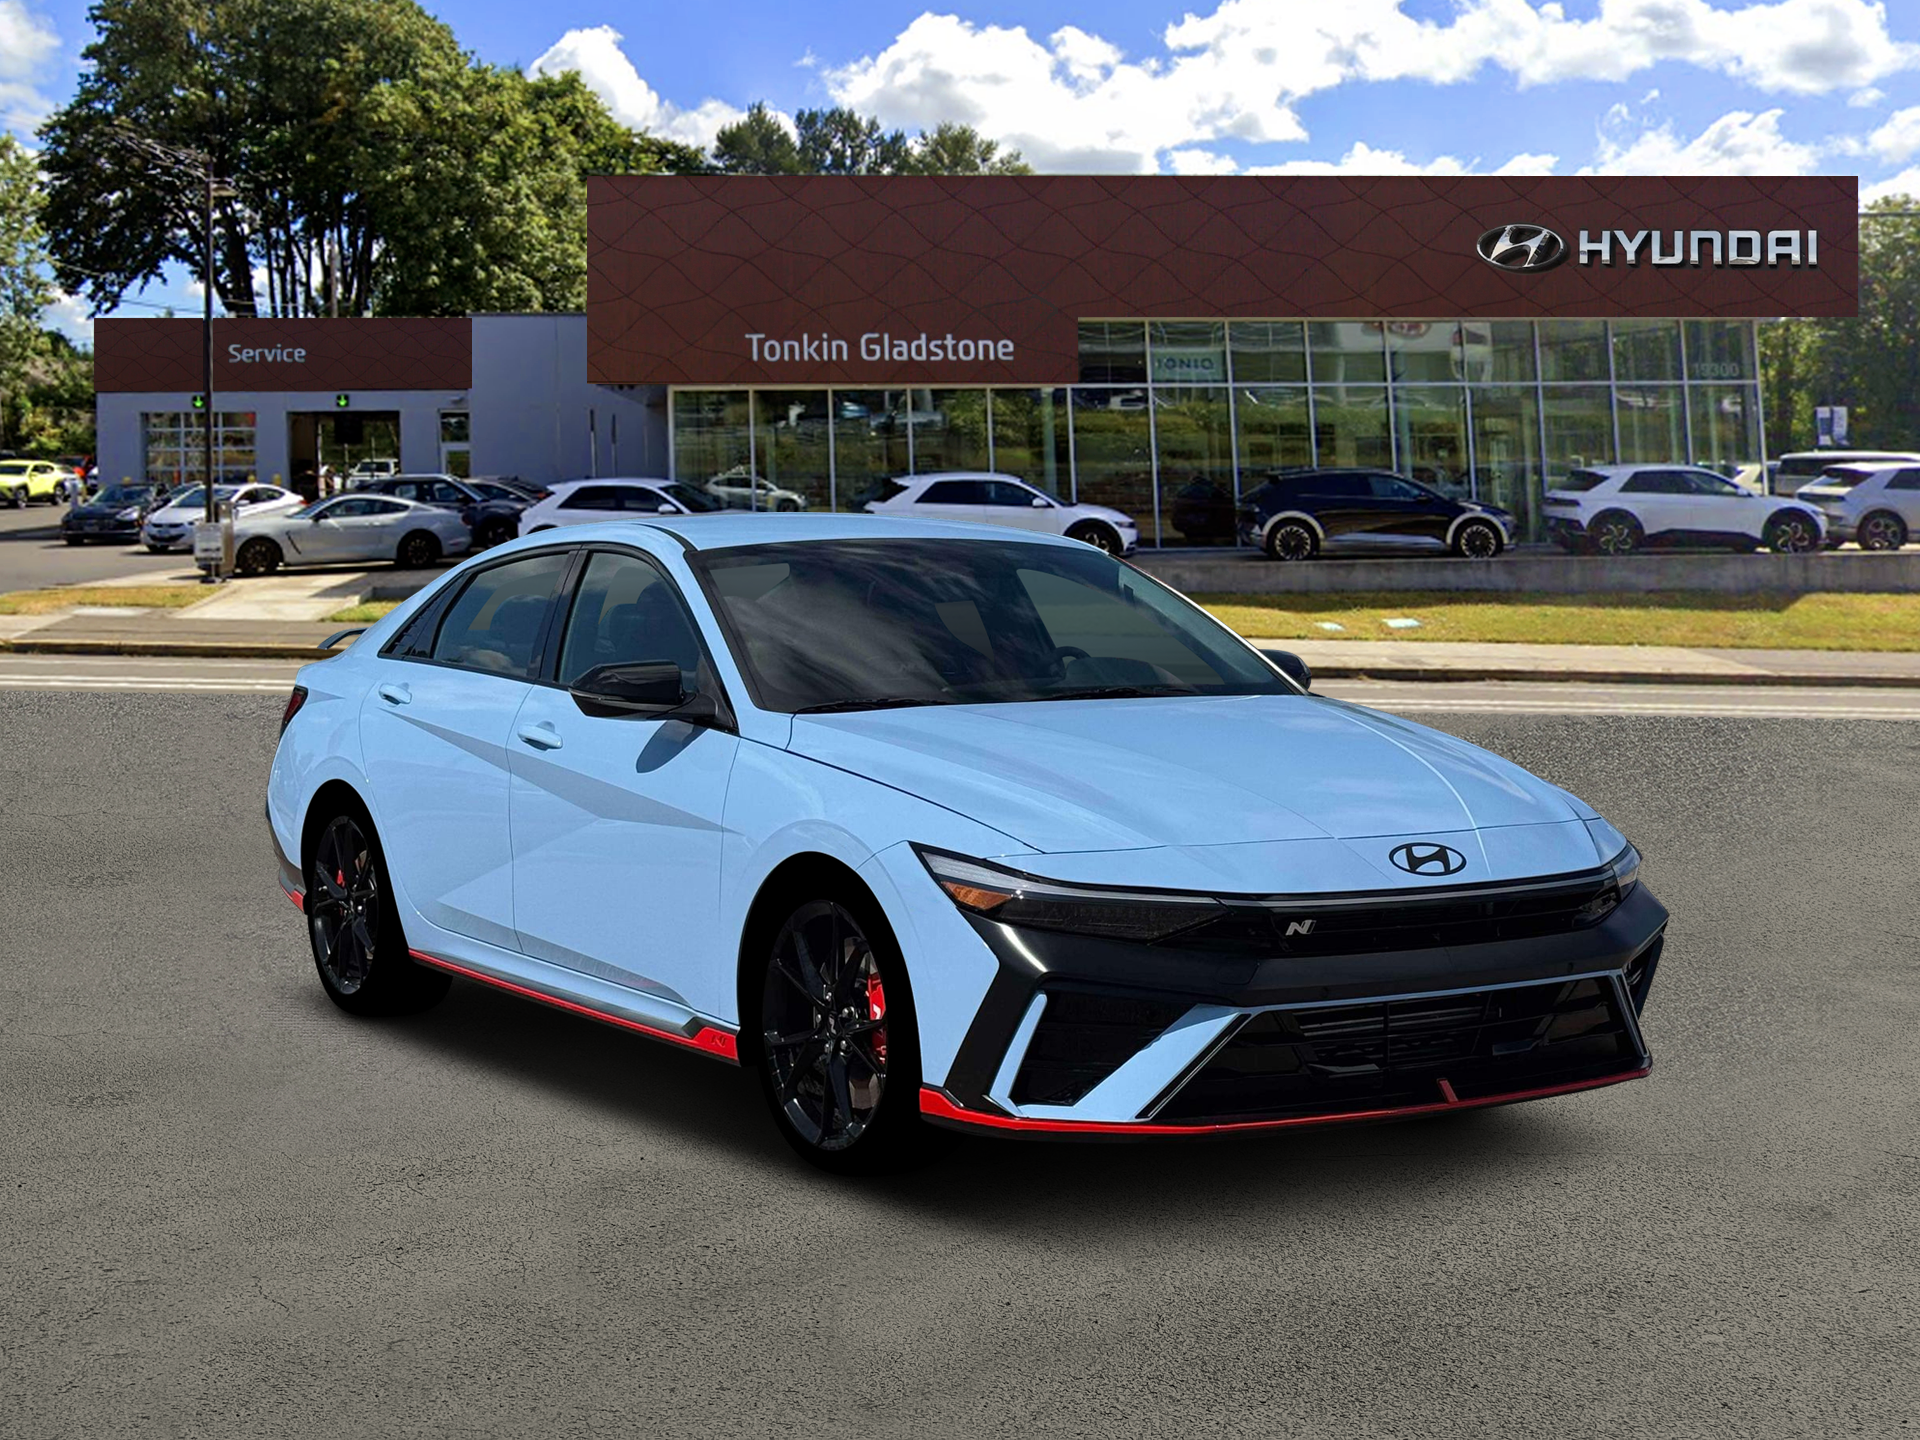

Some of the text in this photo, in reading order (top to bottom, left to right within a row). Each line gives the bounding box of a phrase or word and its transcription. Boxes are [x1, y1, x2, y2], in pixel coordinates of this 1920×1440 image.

[1578, 229, 1818, 265] HYUNDAI
[227, 343, 307, 363] Service
[744, 332, 1015, 362] Tonkin Gladstone
